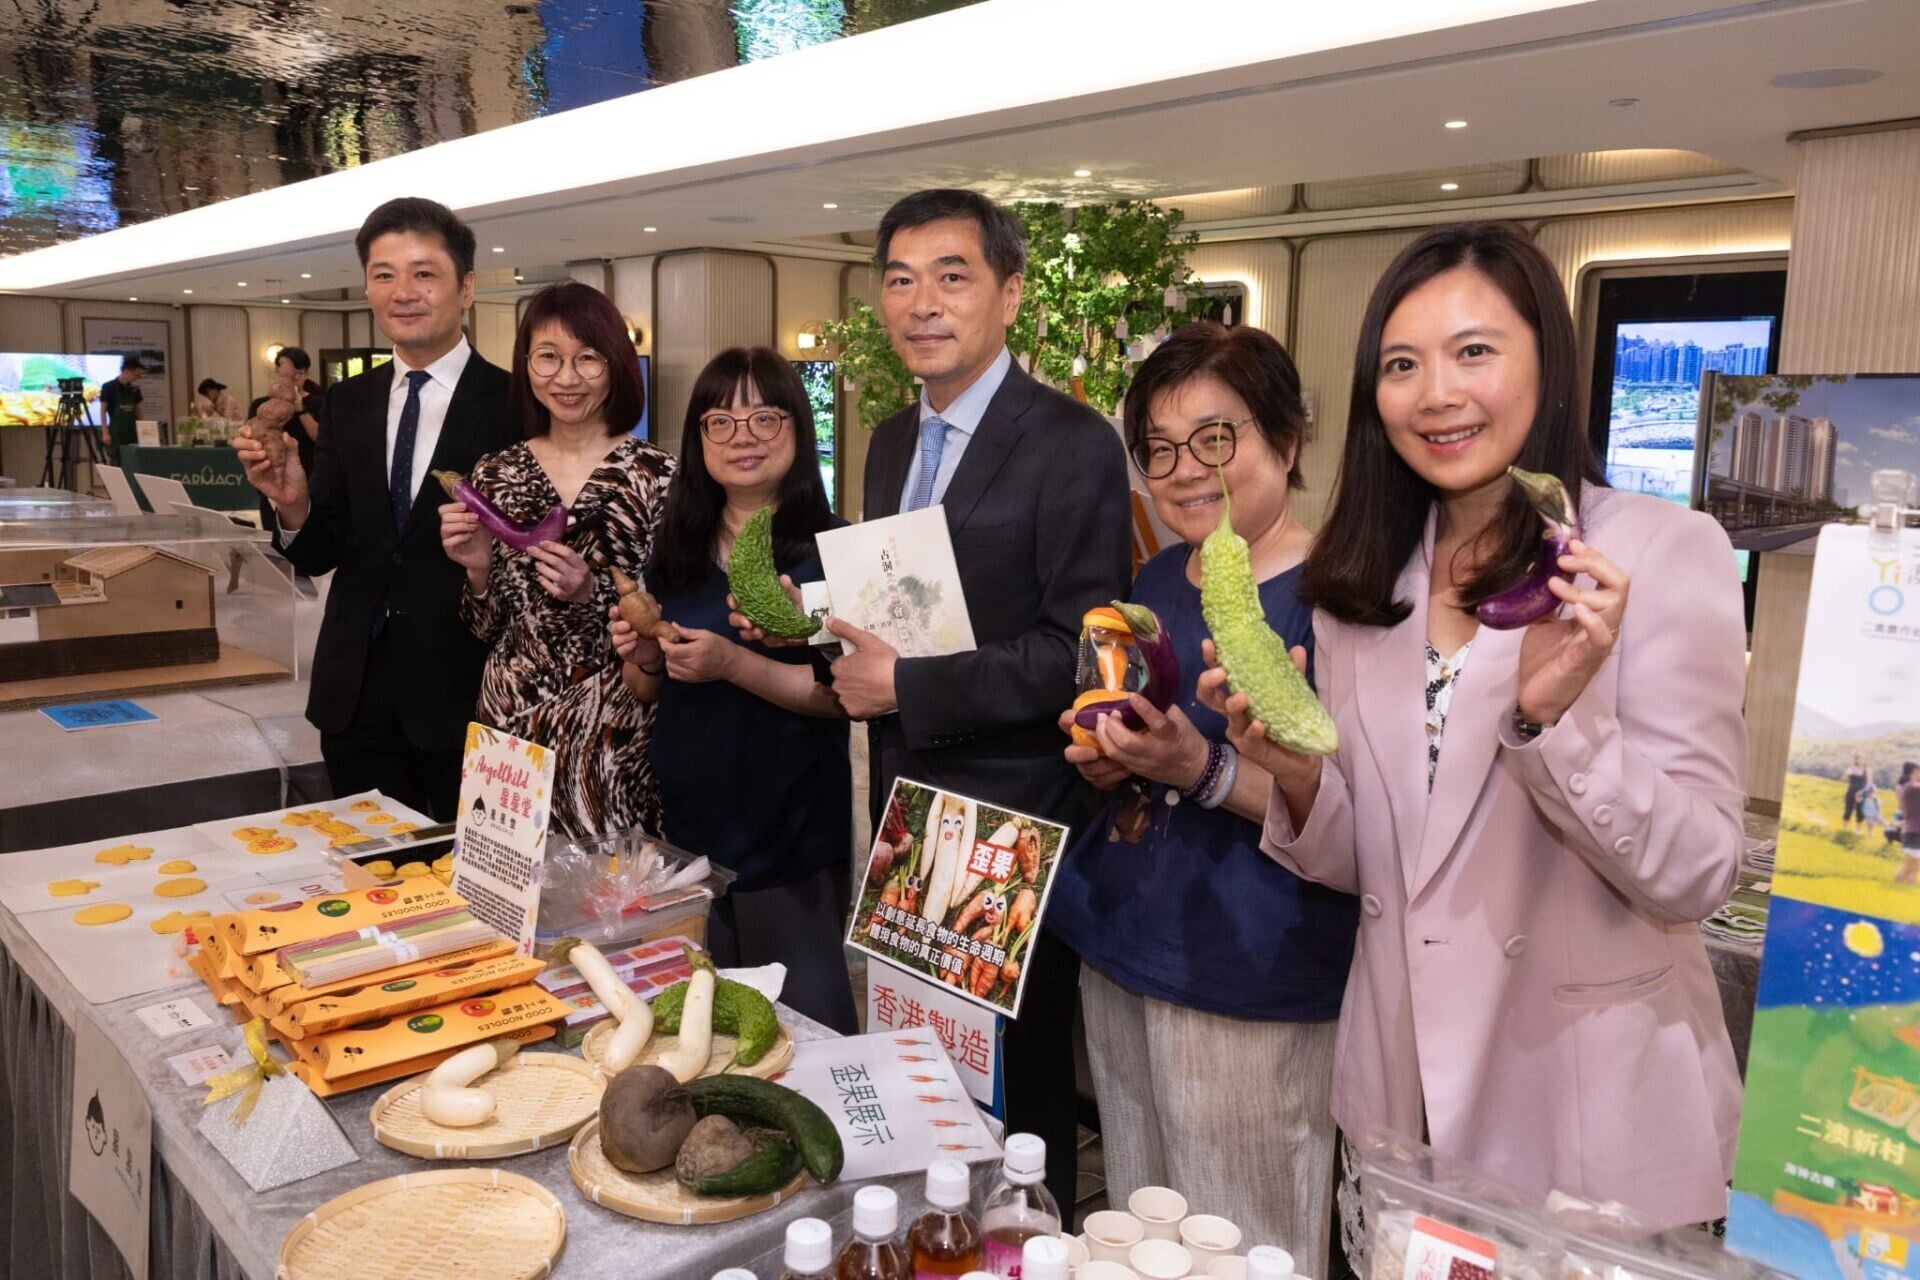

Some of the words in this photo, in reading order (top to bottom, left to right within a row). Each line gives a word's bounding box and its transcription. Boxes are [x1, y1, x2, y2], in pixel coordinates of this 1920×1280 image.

[475, 754, 529, 789] AngelChild
[499, 787, 533, 819] 星星堂
[970, 843, 1016, 880] 歪果
[381, 903, 422, 919] NOODLES
[876, 902, 1006, 968] 以創意延長食物的生命週期
[478, 1013, 519, 1031] NOODLES
[520, 1007, 553, 1020] GOOD
[873, 984, 989, 1075] 香港製造
[830, 1064, 895, 1146] 歪果展示
[1796, 1113, 1908, 1166] 二澳新村
